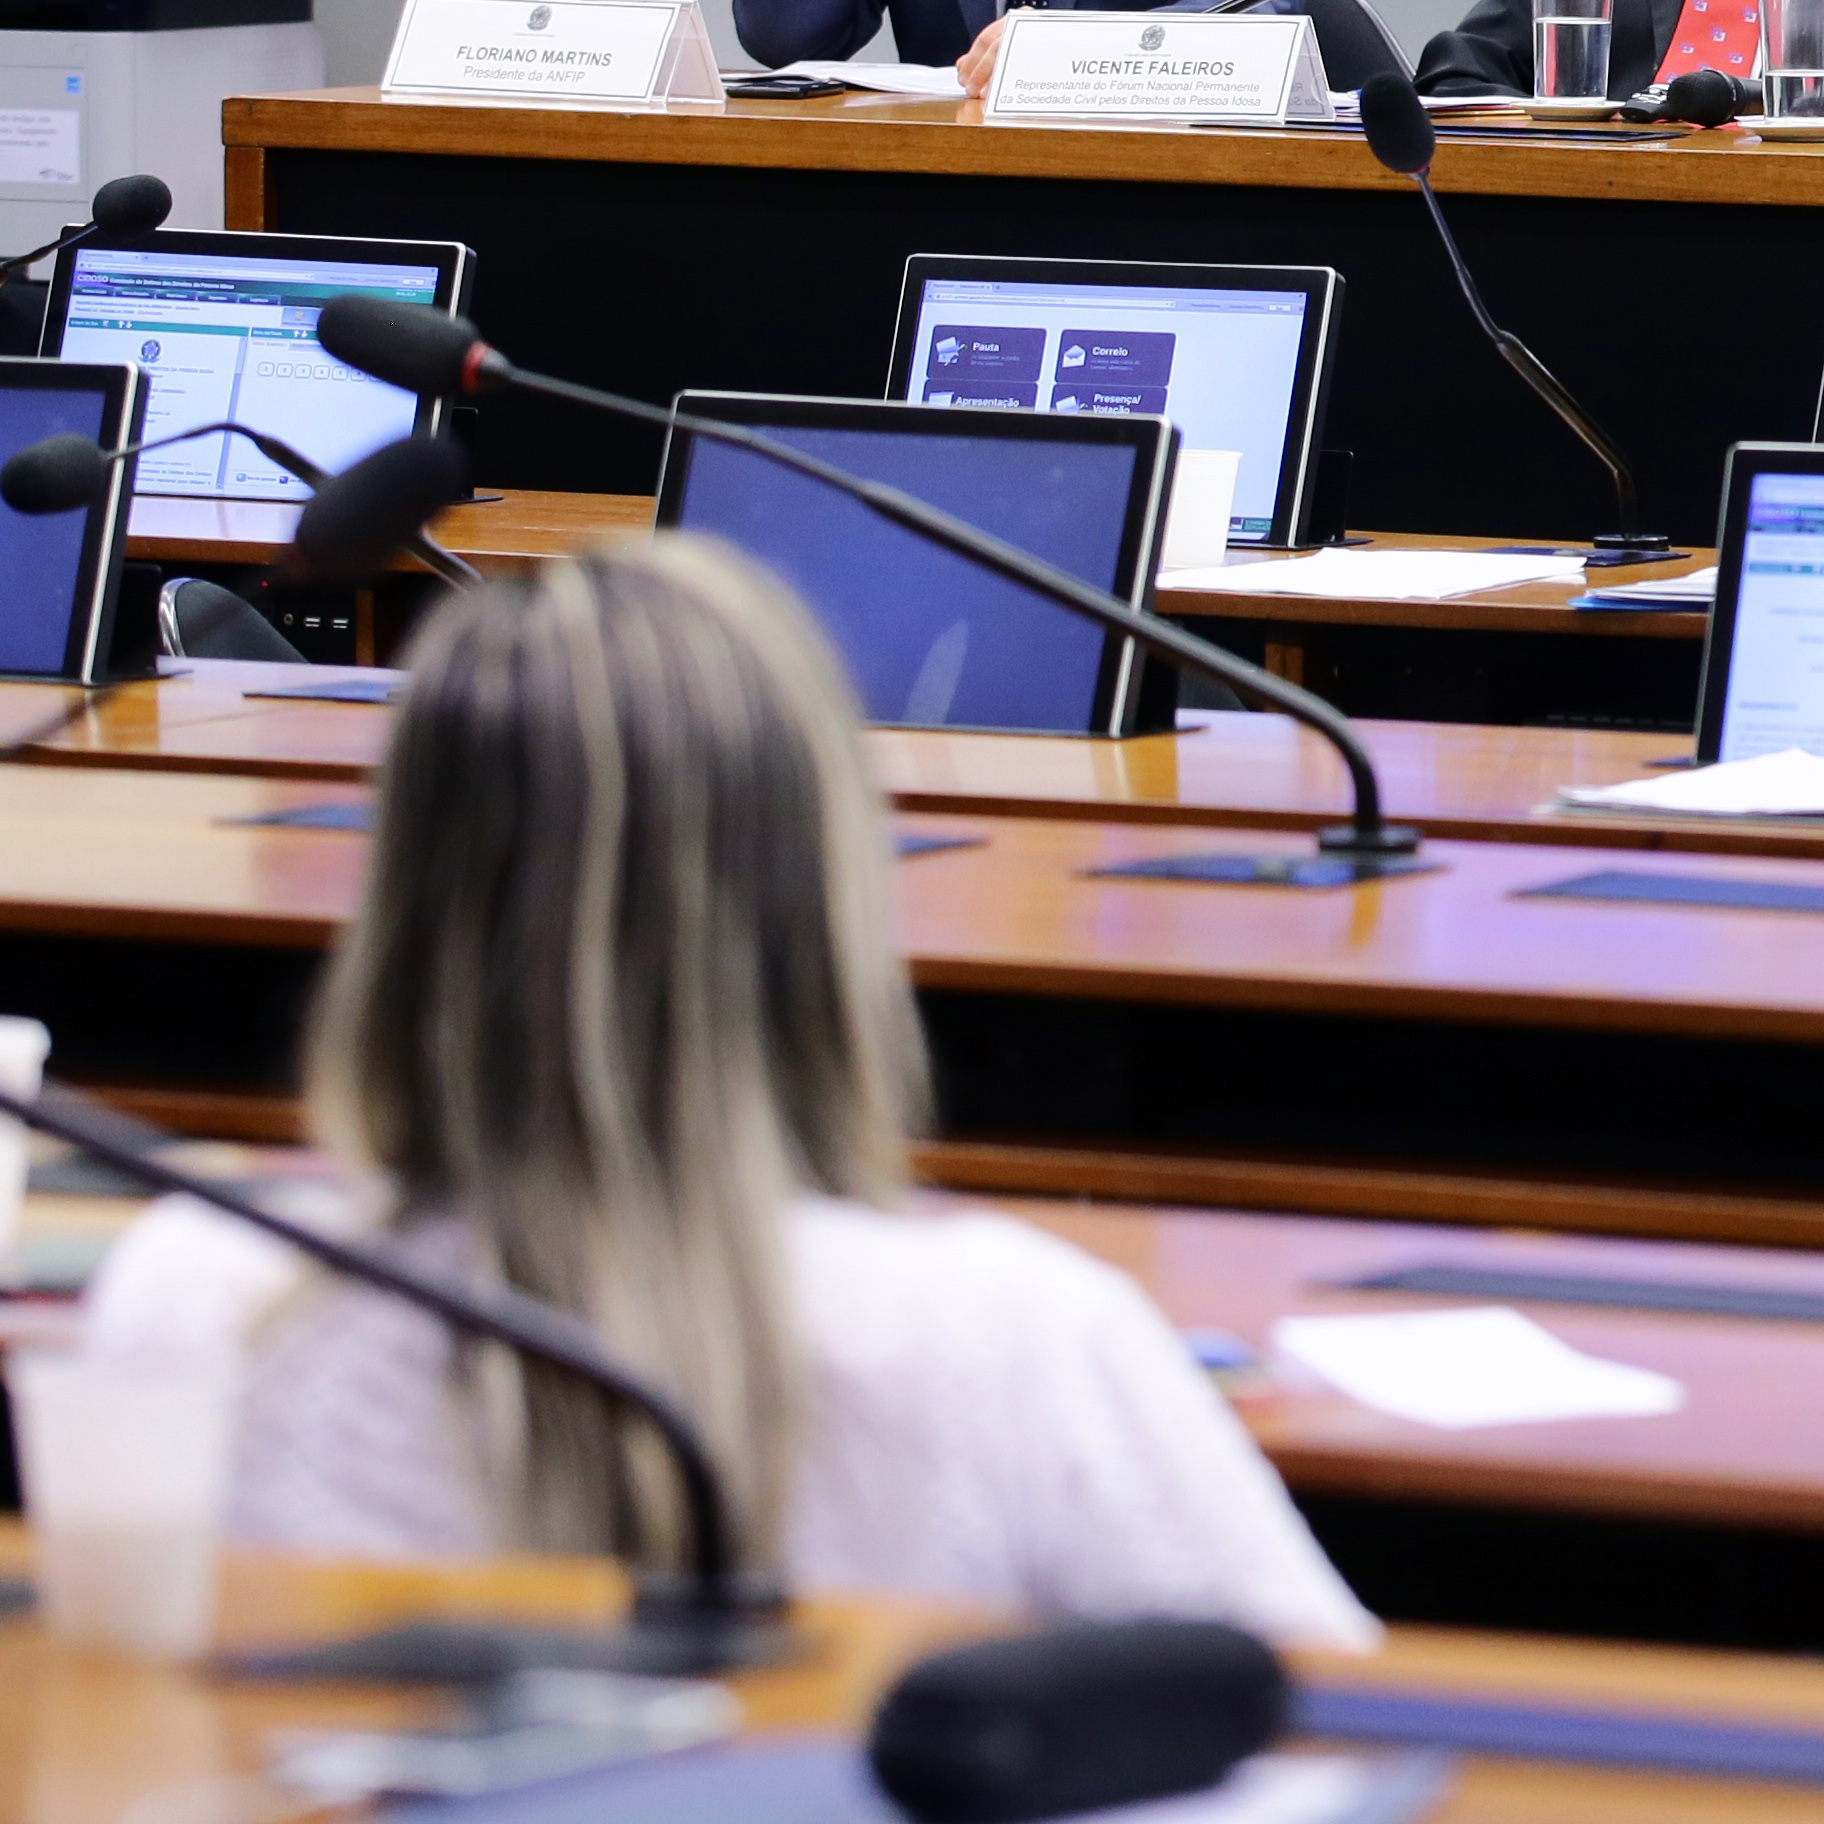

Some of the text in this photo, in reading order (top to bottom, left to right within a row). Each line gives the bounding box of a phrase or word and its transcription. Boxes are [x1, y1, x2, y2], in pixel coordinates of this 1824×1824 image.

[456, 45, 613, 67] FLORIANO MARTINS
[463, 65, 586, 83] Presidente da ANFIP
[1071, 60, 1235, 76] VICENTE FALEIROS
[1015, 79, 1261, 93] Representante do Fórum Nacional Permanente
[1000, 94, 1262, 107] da Sociedade Civil pelos Direitos da Pessoa Idosa
[972, 342, 1000, 352] Pauta
[1092, 346, 1129, 357] Correio
[955, 396, 1020, 409] Apresentação
[1094, 393, 1142, 406] Presença/
[1092, 404, 1131, 415] Votação
